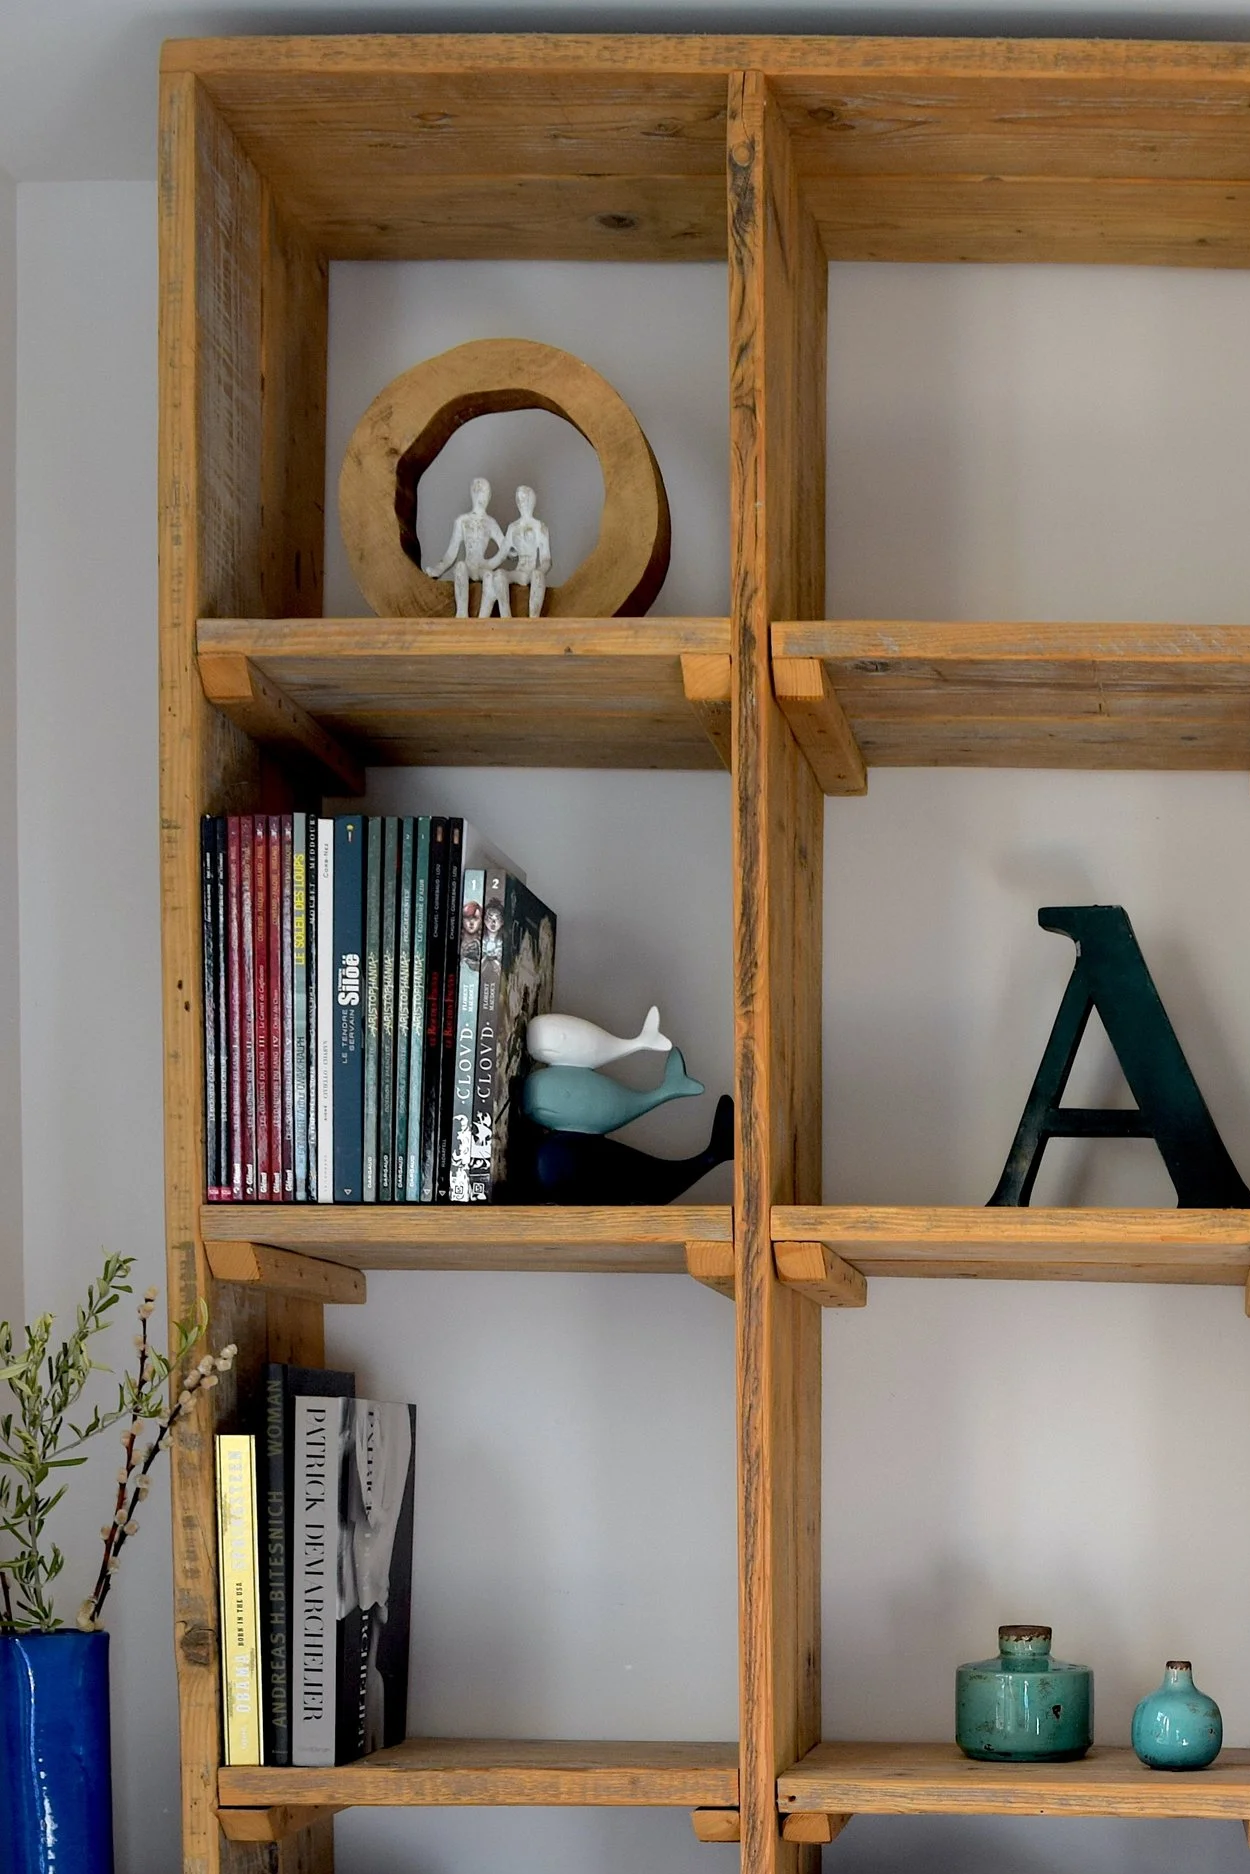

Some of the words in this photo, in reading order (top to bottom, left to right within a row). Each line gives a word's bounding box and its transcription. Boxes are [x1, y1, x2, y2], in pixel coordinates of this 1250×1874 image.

[294, 853, 305, 888] LOUPS
[492, 877, 500, 890] 2
[294, 891, 305, 911] DES
[294, 914, 305, 948] SOLEIL
[294, 956, 304, 965] LE
[337, 954, 360, 1006] Siloë
[368, 951, 378, 1037] ARISTOPHANIA
[382, 950, 393, 1035] ARISTOPHANIA
[399, 951, 409, 1037] ARISTOPHANIA
[413, 951, 424, 1037] ARISTOPHANIA
[342, 1053, 348, 1064] LE
[267, 1379, 283, 1458] WOMAN
[304, 1407, 327, 1513] PATRICK
[228, 1451, 248, 1572] SPRINGSTEEN
[267, 1490, 286, 1602] BITESNICH
[235, 1599, 243, 1613] THE
[236, 1616, 243, 1625] IN
[269, 1606, 286, 1625] H.
[303, 1523, 326, 1722] DEMARCHELIER
[236, 1627, 244, 1647] BORN
[233, 1654, 252, 1714] OBAMA
[270, 1632, 288, 1729] ANDREAS
